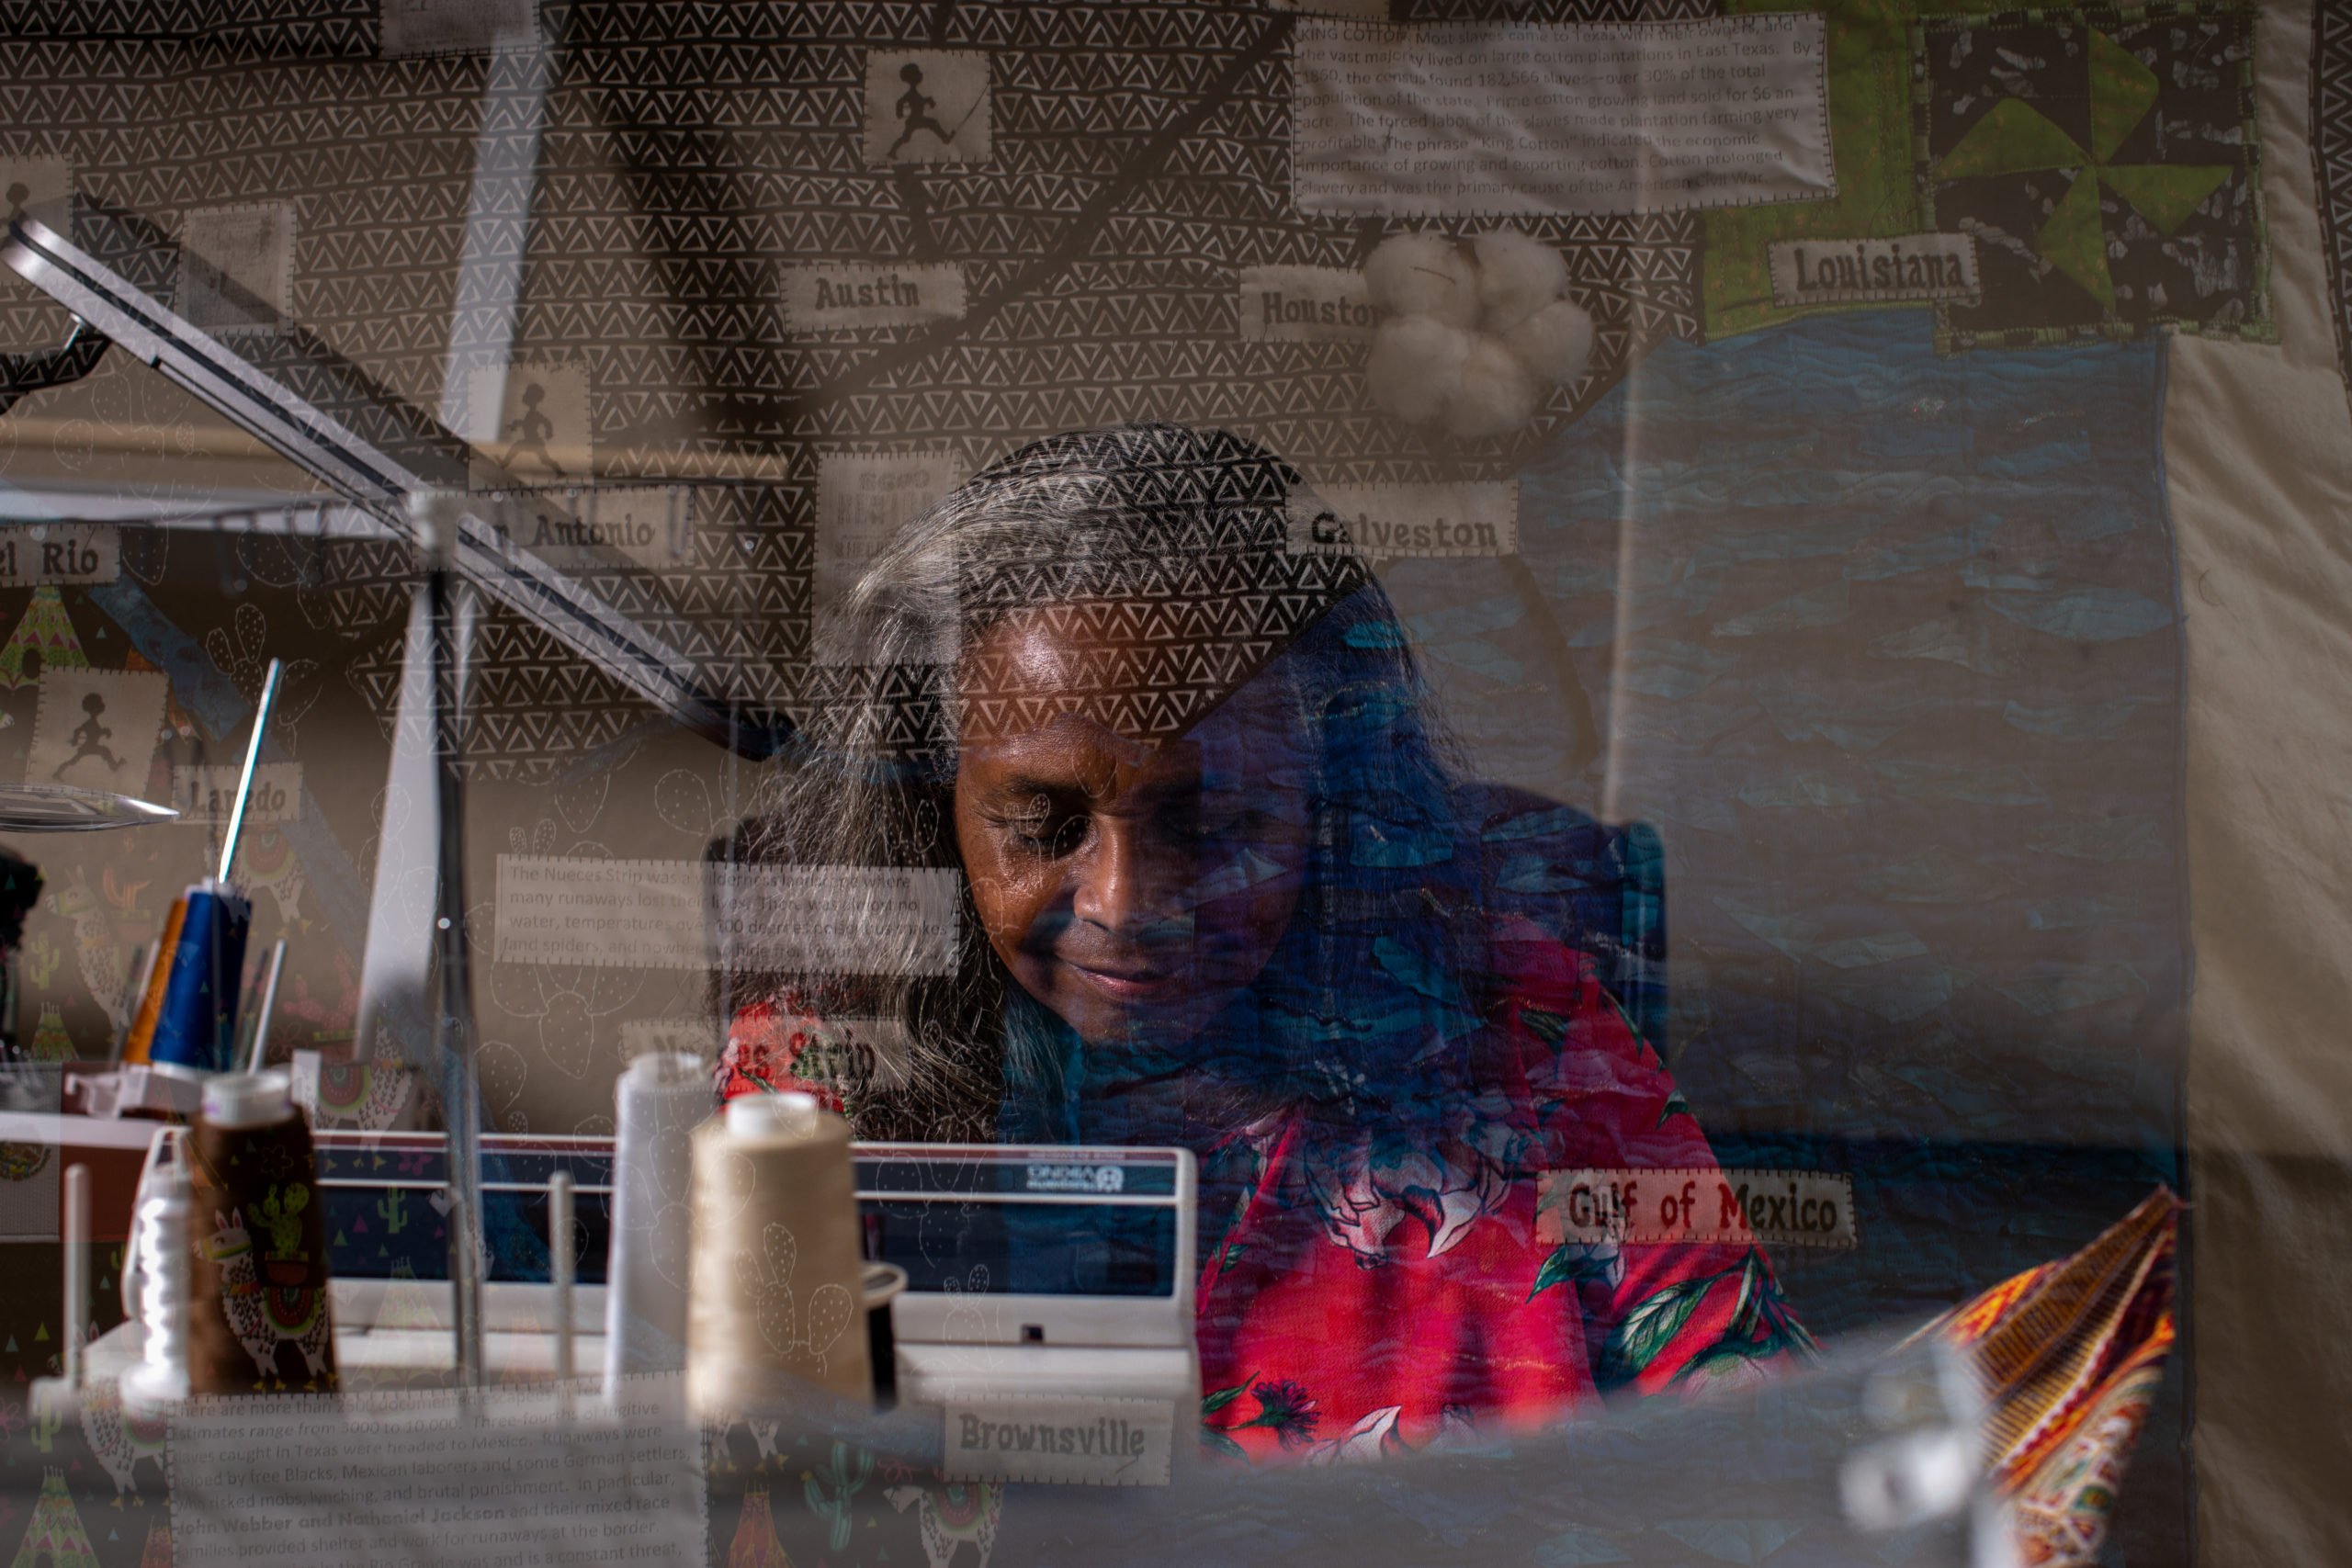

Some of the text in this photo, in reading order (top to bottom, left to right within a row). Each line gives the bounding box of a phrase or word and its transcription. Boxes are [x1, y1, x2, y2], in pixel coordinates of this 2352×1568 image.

[1301, 28, 1338, 42] KING
[1416, 32, 1454, 44] Most
[1509, 32, 1547, 42] came
[1554, 30, 1569, 41] to
[1573, 29, 1616, 42] Texas
[1658, 28, 1694, 40] their
[1765, 21, 1792, 32] and
[1301, 49, 1325, 60] the
[1330, 51, 1360, 61] vast
[1429, 51, 1463, 65] lived
[1468, 53, 1487, 64] on
[1493, 50, 1530, 64] large
[1534, 51, 1583, 63] cotton
[1589, 49, 1673, 64] plantations
[1679, 49, 1690, 60] in
[1697, 46, 1728, 58] East
[1733, 42, 1779, 56] Texas.
[1793, 41, 1811, 56] By
[1347, 73, 1371, 85] the
[1376, 73, 1426, 85] census
[1430, 73, 1472, 87] found
[1645, 69, 1675, 82] 30%
[1680, 67, 1696, 81] of
[1702, 65, 1724, 79] the
[1731, 63, 1765, 78] total
[1303, 86, 1793, 108] population of the Prime cotton growing land sold for $6 an
[1348, 107, 1799, 129] The forced labor of slaves made plantation farming very
[1417, 138, 1468, 152] phrase
[1686, 131, 1759, 147] economic
[1301, 150, 1782, 176] importance of growing and exporting cotton. Cotton prolonged
[1301, 182, 1354, 196] slavery
[1360, 182, 1386, 194] and
[1393, 184, 1422, 195] was
[1427, 180, 1452, 195] the
[1457, 183, 1516, 197] primary
[1521, 183, 1564, 194] cause
[1569, 179, 1584, 194] of
[1589, 179, 1613, 192] the
[1794, 243, 1969, 291] Louisiana
[815, 274, 920, 310] Austin
[533, 513, 656, 546] Antonio
[1311, 512, 1498, 547] Galveston
[42, 538, 98, 575] Rio
[511, 867, 677, 885] The Nueces Strip was
[510, 892, 918, 911] many runaways lost no
[510, 916, 672, 933] water, temperatures
[544, 939, 638, 955] spiders, and
[1569, 1181, 1838, 1233] Gulf of Mexico
[220, 1399, 332, 1416] are more than
[249, 1422, 335, 1439] range from
[959, 1413, 1146, 1456] Brownsville
[220, 1447, 272, 1462] caught
[277, 1445, 290, 1459] in
[295, 1443, 338, 1458] Texas
[344, 1443, 382, 1455] were
[387, 1439, 445, 1454] headed
[451, 1438, 467, 1450] to
[543, 1428, 619, 1447] Runaways
[624, 1426, 662, 1439] were
[227, 1446, 691, 1487] by Blacks, Mexican laborers and some German settlers,
[209, 1471, 675, 1509] risked mobs, lynching, and brutal punishment. In particular,
[220, 1515, 293, 1533] Webber
[298, 1512, 333, 1529] and
[337, 1506, 424, 1527] Nathaniel
[431, 1505, 505, 1524] Jackson
[509, 1505, 538, 1519] and
[544, 1501, 581, 1516] their
[585, 1497, 632, 1514] mixed
[636, 1496, 670, 1510] race
[238, 1519, 660, 1559] provided shelter and work for runaways at the border.
[494, 1542, 682, 1568] and constant threat,
